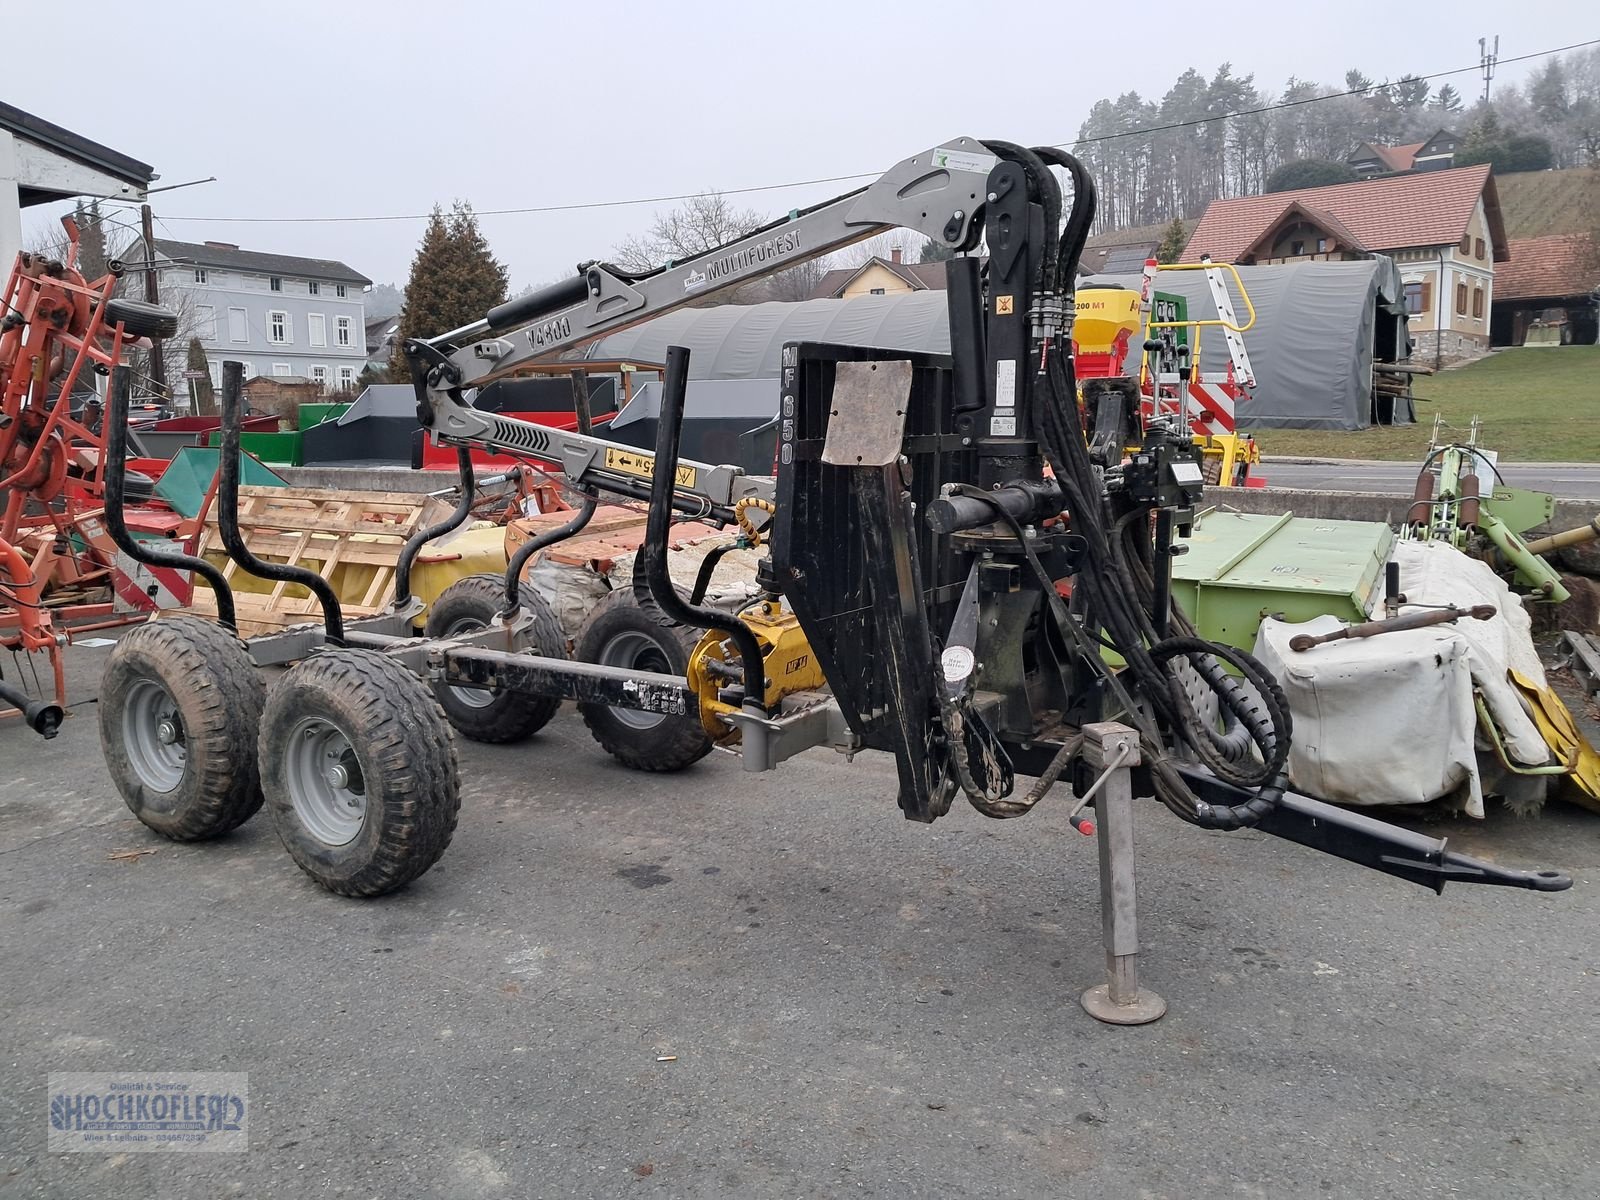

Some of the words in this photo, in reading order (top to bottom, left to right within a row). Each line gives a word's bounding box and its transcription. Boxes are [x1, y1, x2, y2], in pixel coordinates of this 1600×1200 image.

[706, 229, 801, 281] MULTIFOREST
[1076, 302, 1090, 310] 200
[1092, 302, 1105, 310] M1
[525, 316, 571, 351] V4800
[781, 395, 795, 465] 650
